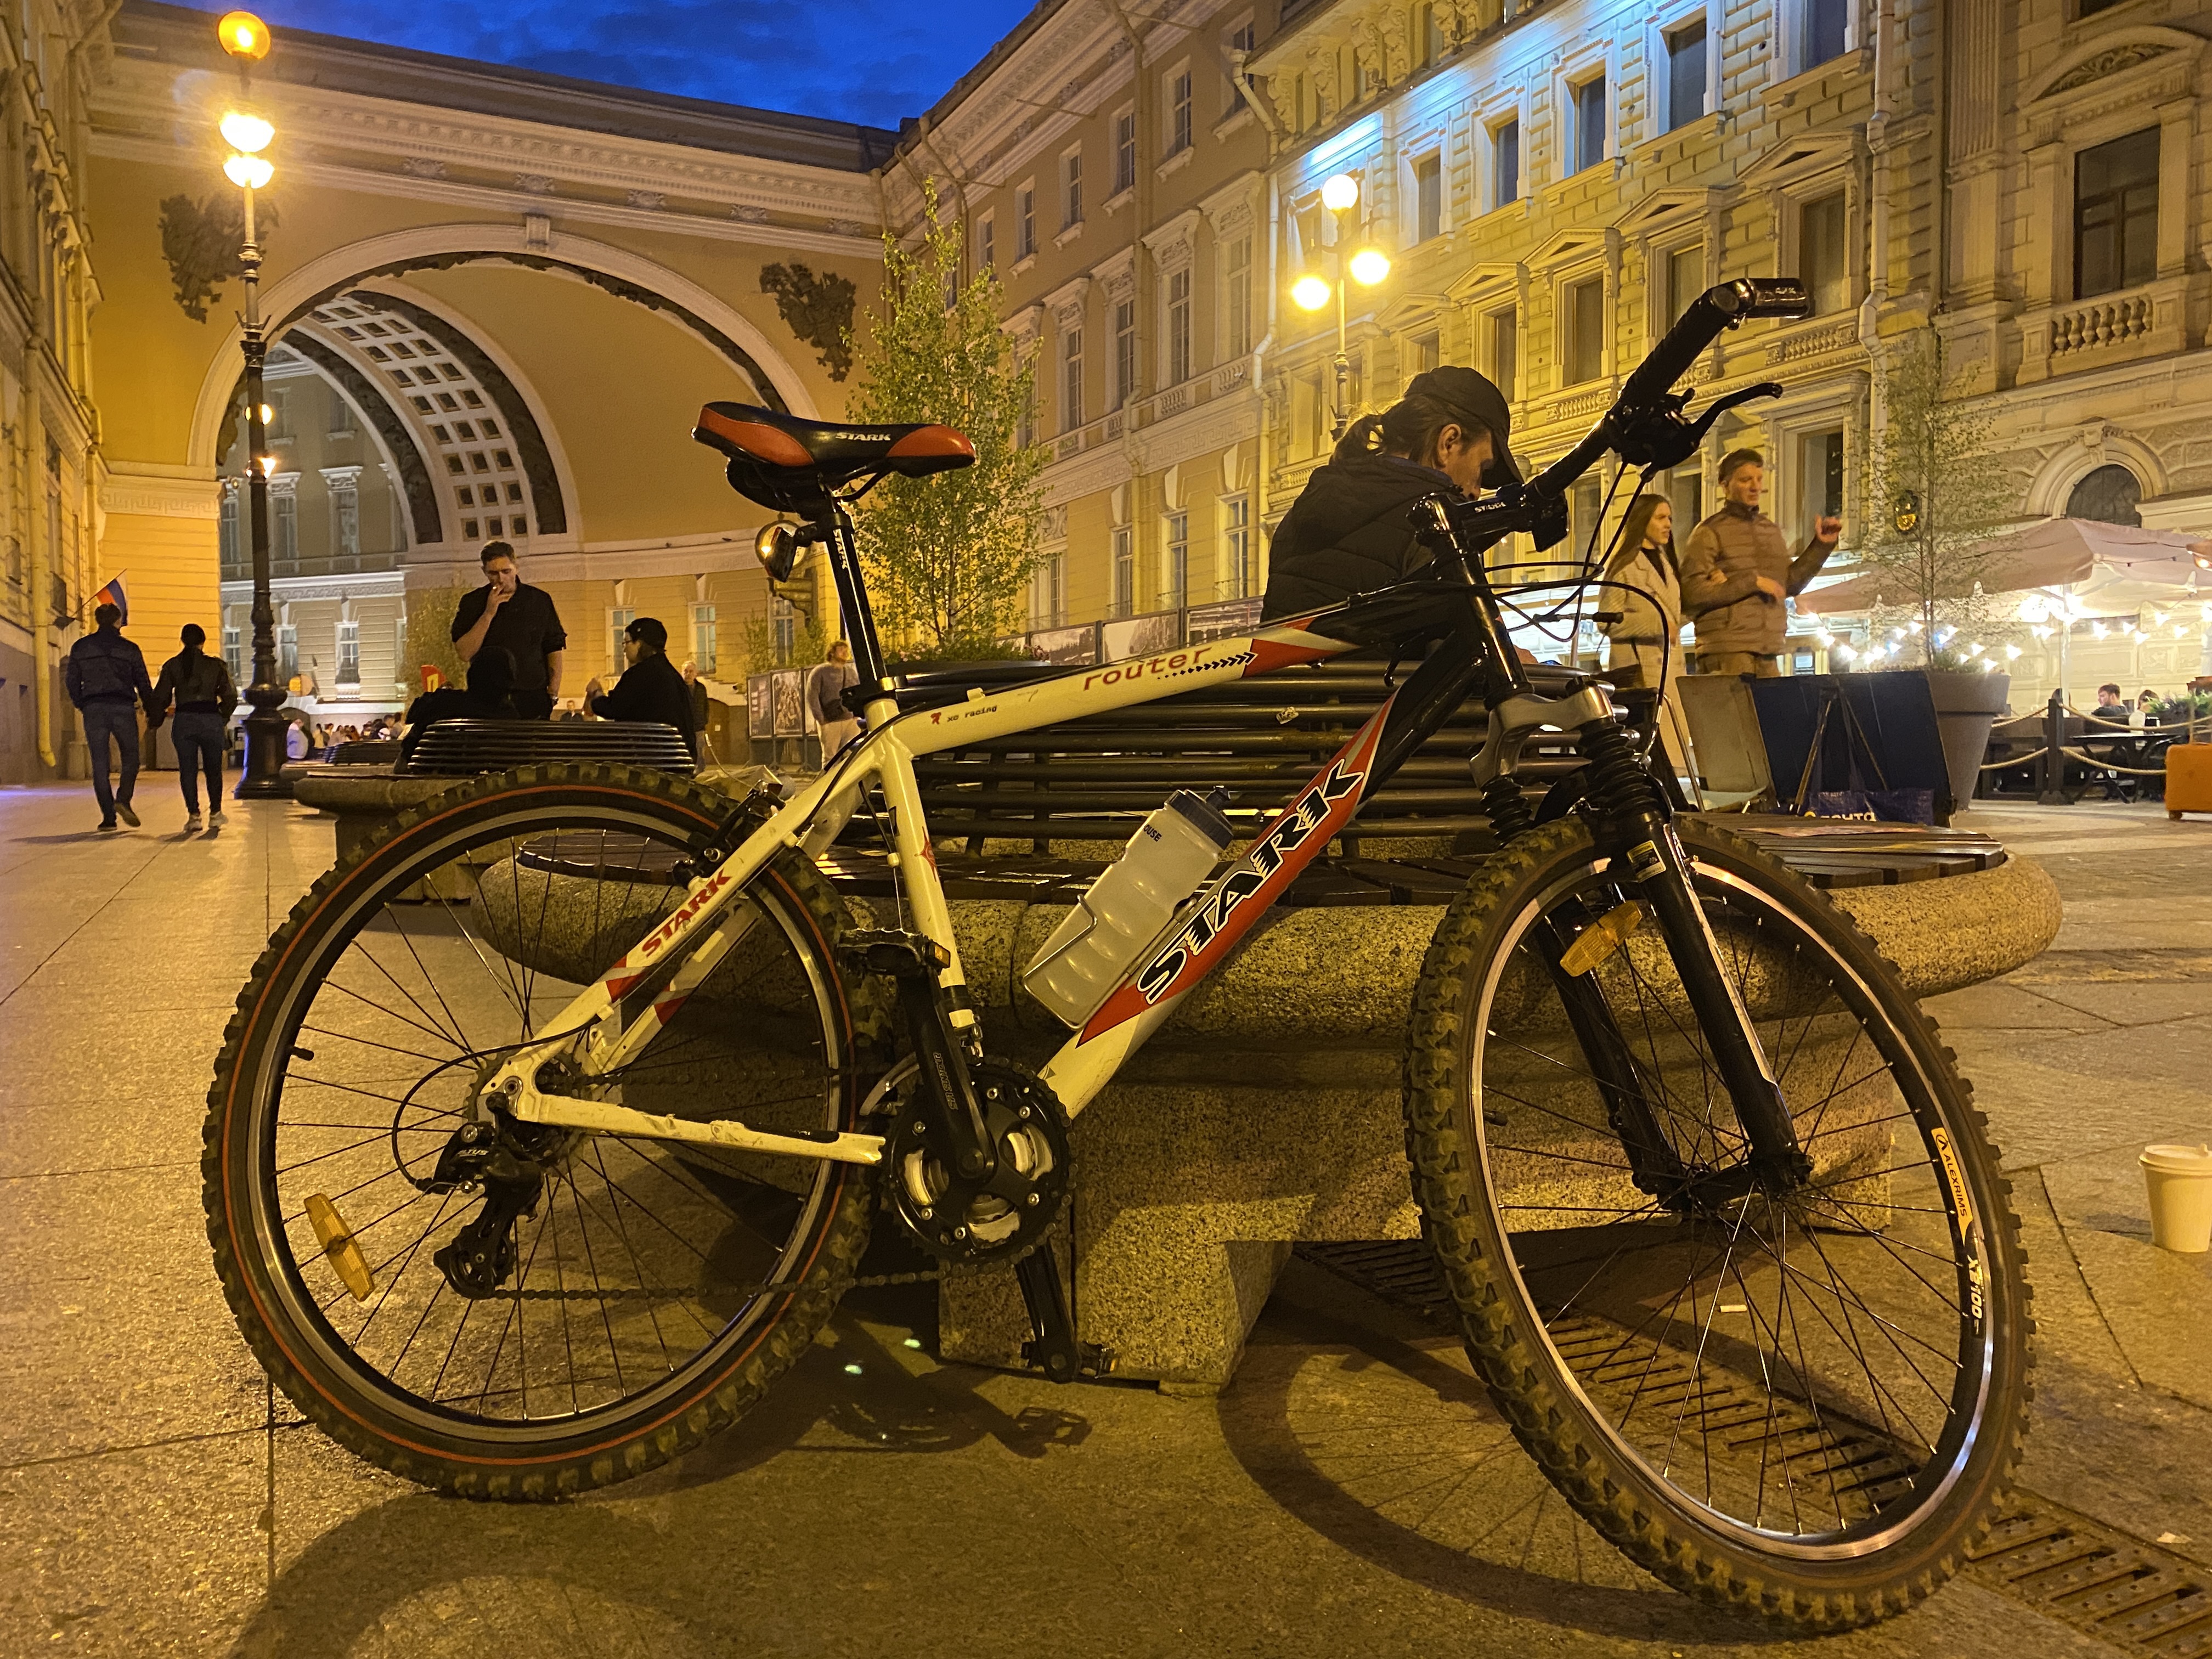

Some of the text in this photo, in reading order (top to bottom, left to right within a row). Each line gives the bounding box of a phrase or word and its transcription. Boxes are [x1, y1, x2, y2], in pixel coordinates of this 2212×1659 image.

[836, 432, 891, 441] STARK
[1083, 647, 1212, 691] router
[964, 706, 997, 718] racing
[1137, 758, 1364, 1005] STARK
[642, 867, 732, 958] STARK
[1944, 1154, 1967, 1216] ALEXRIMS
